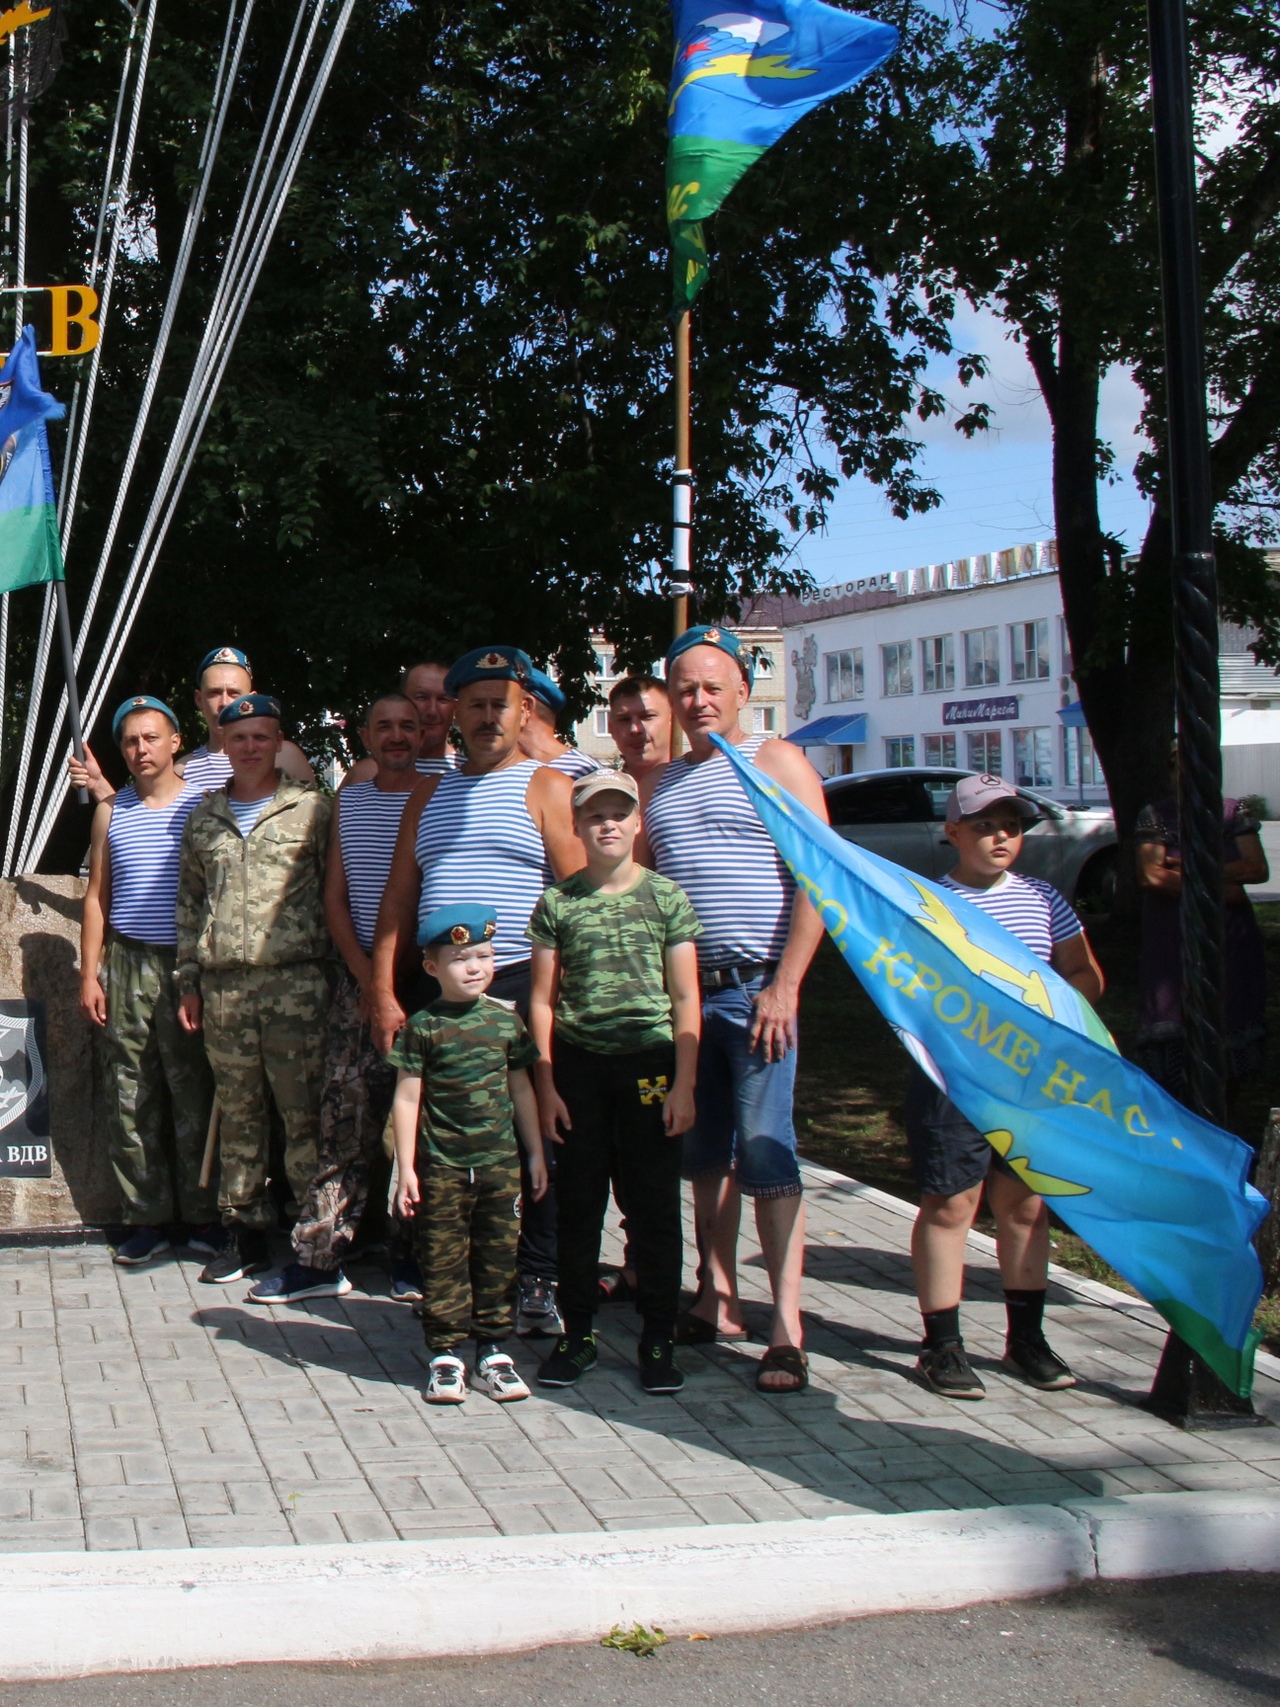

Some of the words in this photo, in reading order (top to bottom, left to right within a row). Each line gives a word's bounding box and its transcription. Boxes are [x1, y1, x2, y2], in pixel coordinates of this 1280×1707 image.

[802, 573, 890, 603] РЕСТОРАН
[862, 937, 1041, 1077] КРОМЕ
[7, 1144, 48, 1166] ВДВ
